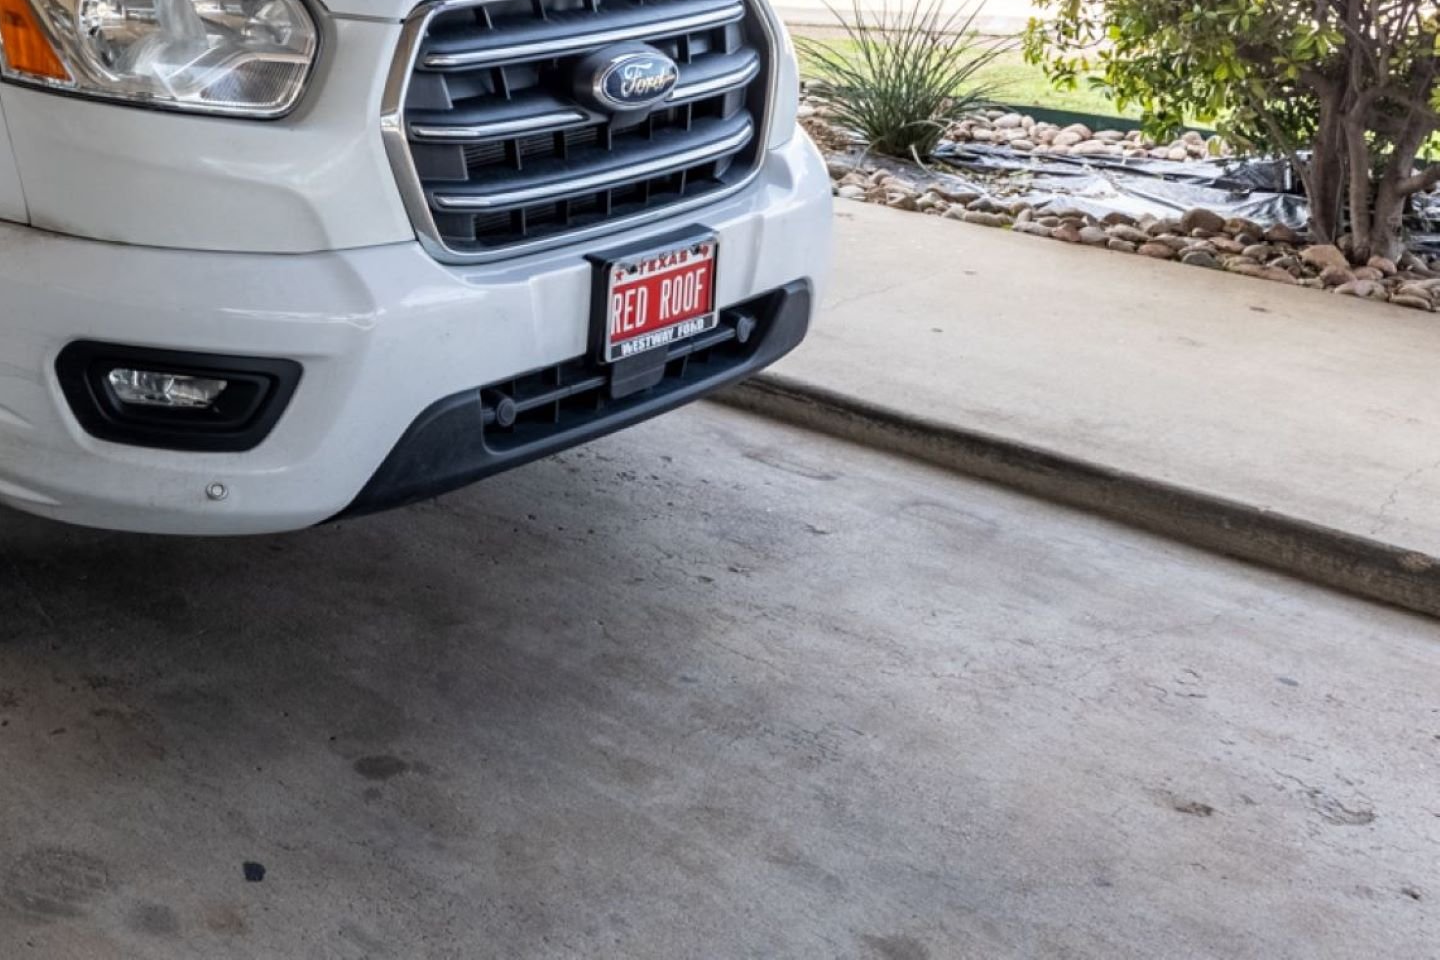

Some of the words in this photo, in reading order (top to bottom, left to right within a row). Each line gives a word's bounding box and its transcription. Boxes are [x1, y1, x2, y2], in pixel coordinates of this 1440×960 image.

[621, 62, 676, 98] Ford
[639, 248, 688, 275] TEXAS
[610, 286, 648, 336] RED
[659, 267, 707, 321] ROOF
[621, 327, 674, 357] WESTWAY
[677, 318, 704, 339] FORD
